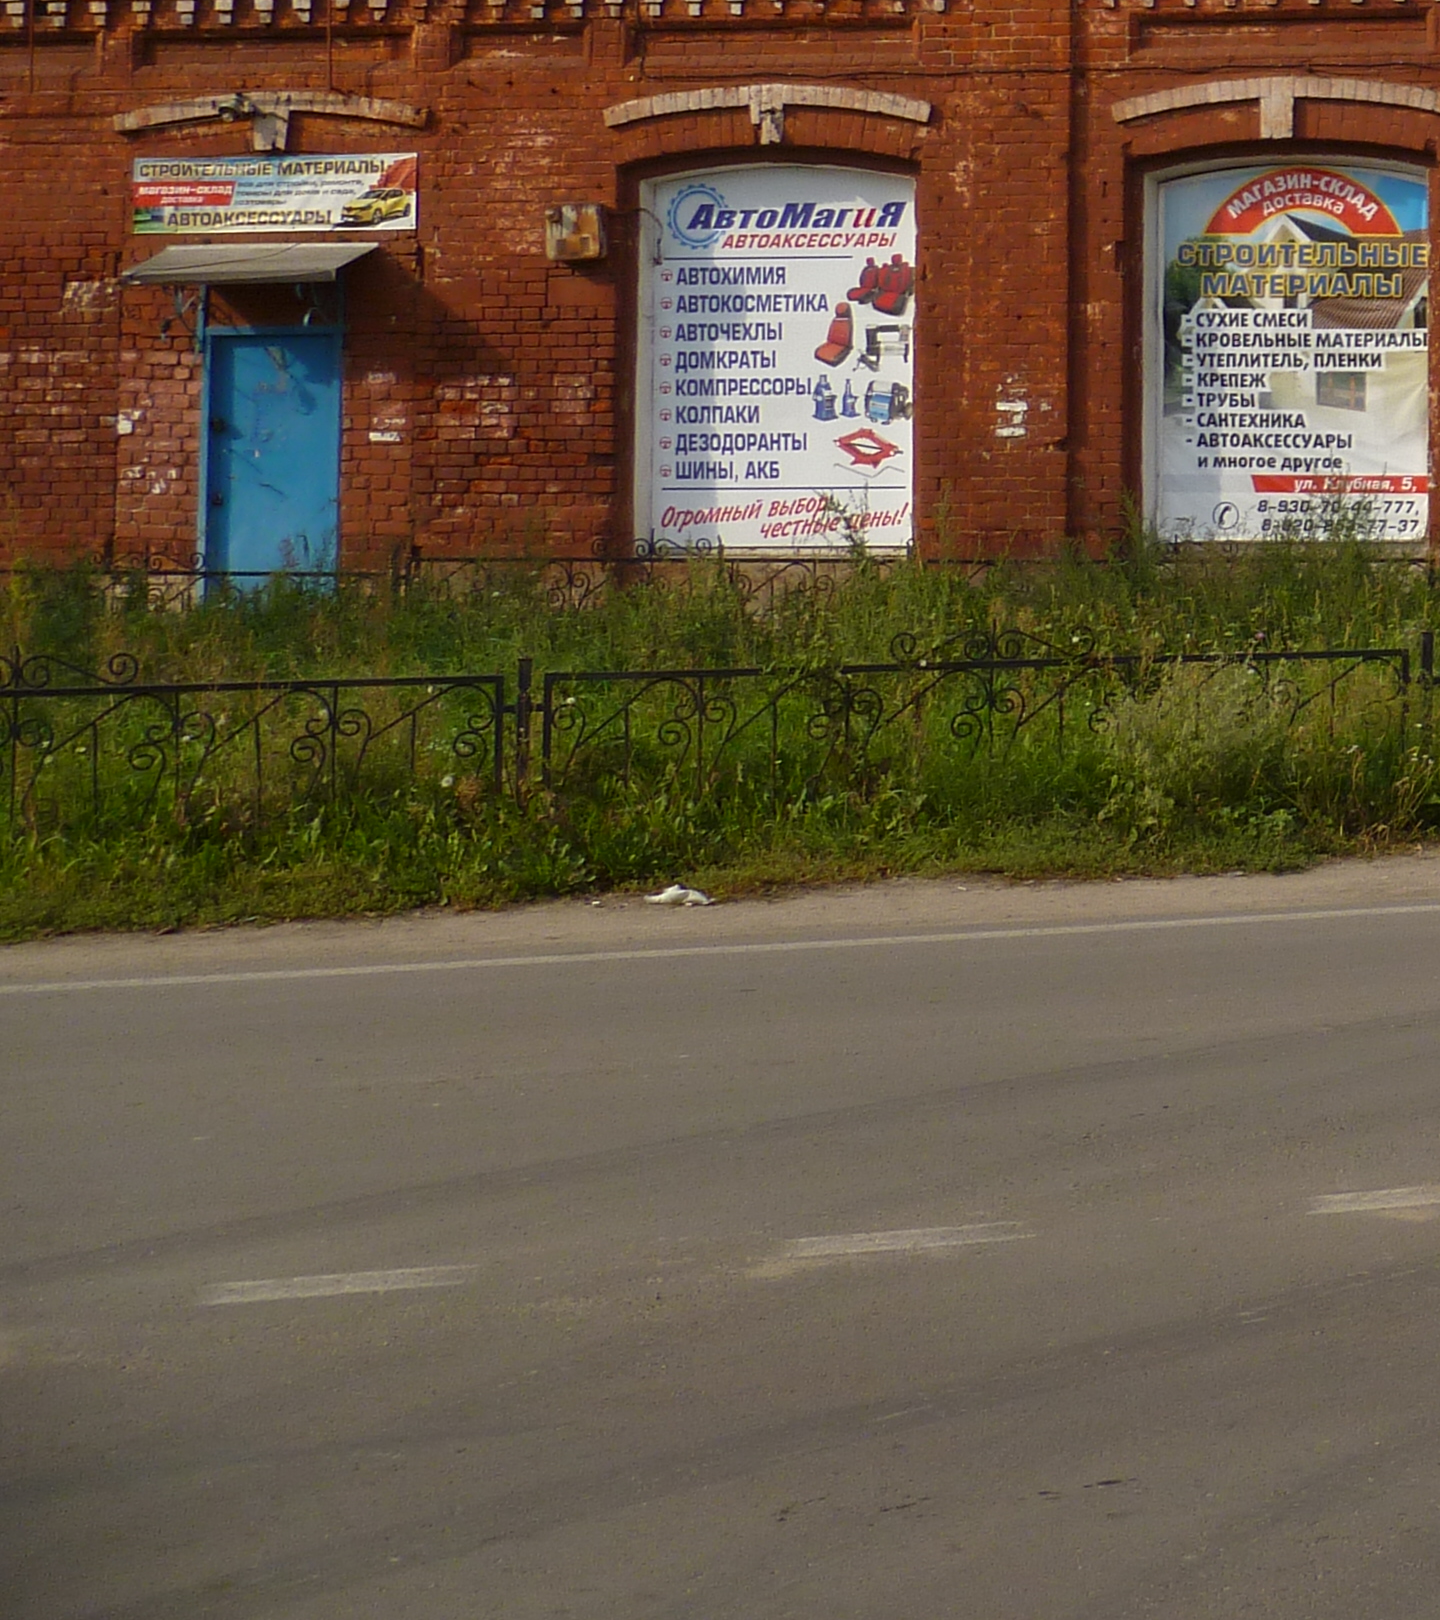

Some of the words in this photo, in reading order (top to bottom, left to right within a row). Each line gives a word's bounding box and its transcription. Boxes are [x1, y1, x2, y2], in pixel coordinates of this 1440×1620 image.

[139, 161, 272, 177] СТРОИТЕЛЬНЫЕ
[277, 159, 385, 176] МАТЕРИАЛЫ
[1226, 173, 1379, 221] МАГАЗИН-СКЛАД
[1262, 192, 1345, 216] доставка
[167, 209, 333, 227] АВТОАКСЕССУАРЫ
[722, 233, 897, 249] АВТОАКСЕССУАРЫ
[1177, 242, 1428, 268] СТРОИТЕЛЬНЫЕ
[676, 266, 786, 285] АВТОХИМИЯ
[1201, 272, 1403, 298] МАТЕРИАЛЫ
[676, 294, 829, 313] АВТОКОСМЕТИКА
[1196, 312, 1249, 328] СУХИЕ
[1253, 312, 1308, 328] СМЕСИ
[675, 322, 783, 342] АВТОЧЕХЛЫ
[1196, 333, 1311, 348] КРОВЕЛЬНЫЕ
[1316, 332, 1428, 347] МАТЕРИАЛЫ
[675, 351, 777, 371] ДОМКРАТЫ
[1196, 353, 1309, 370] УТЕПЛИТЕЛЬ,
[1314, 353, 1382, 368] ПЛЕНКИ
[675, 377, 812, 396] КОМПРЕССОРЫ
[1197, 373, 1266, 388] КРЕПЕЖ
[1197, 393, 1255, 408] ТРУБЫ
[675, 405, 760, 424] КОЛПАКИ
[1197, 413, 1306, 428] САНТЕХНИКА
[675, 433, 808, 455] ДЕЗОДОРАНТЫ
[1197, 433, 1352, 449] АВТОАКСЕССУАРЫ
[675, 461, 738, 482] ШИНЫ,
[744, 461, 780, 480] АКБ
[1198, 456, 1208, 468] и
[1213, 456, 1276, 469] многое
[1281, 456, 1342, 472] другое
[1294, 479, 1317, 492] ул.
[1401, 477, 1418, 492] 5,
[661, 499, 762, 532] Огромный
[761, 517, 839, 538] честные
[848, 502, 909, 530] цены!
